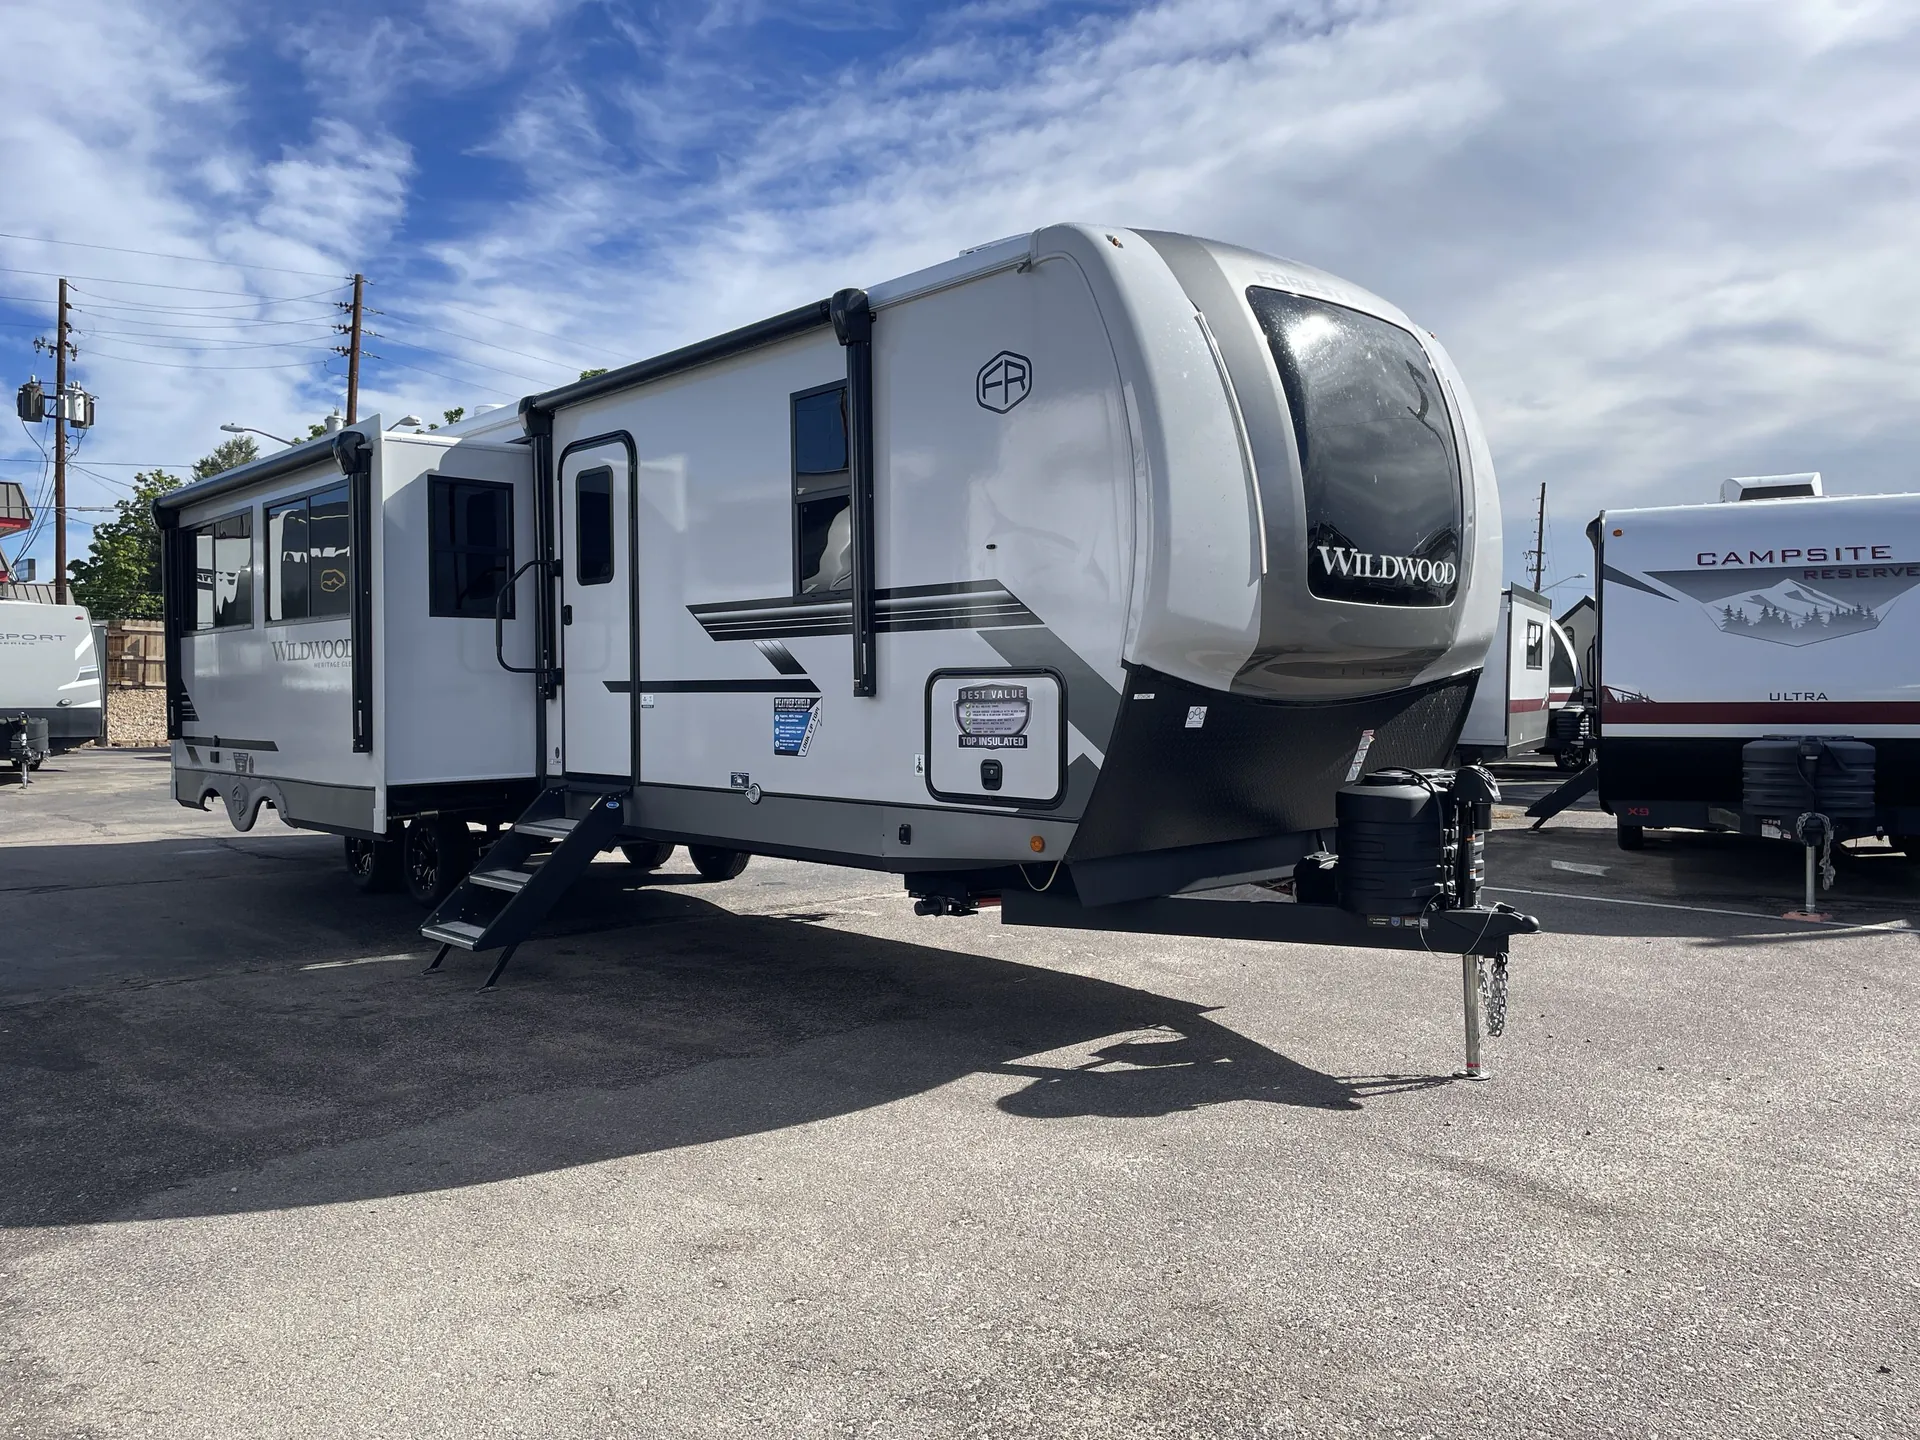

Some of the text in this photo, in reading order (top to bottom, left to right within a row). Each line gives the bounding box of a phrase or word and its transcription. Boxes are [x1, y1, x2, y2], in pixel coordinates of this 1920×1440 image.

[1696, 545, 1893, 566] CAMPSITE
[1316, 545, 1457, 585] WILDWOOD
[1803, 566, 1920, 580] RESERVE
[961, 689, 1024, 700] BEST VALUE
[1769, 692, 1829, 701] ULTRA
[961, 737, 1024, 746] TOP INSULATED
